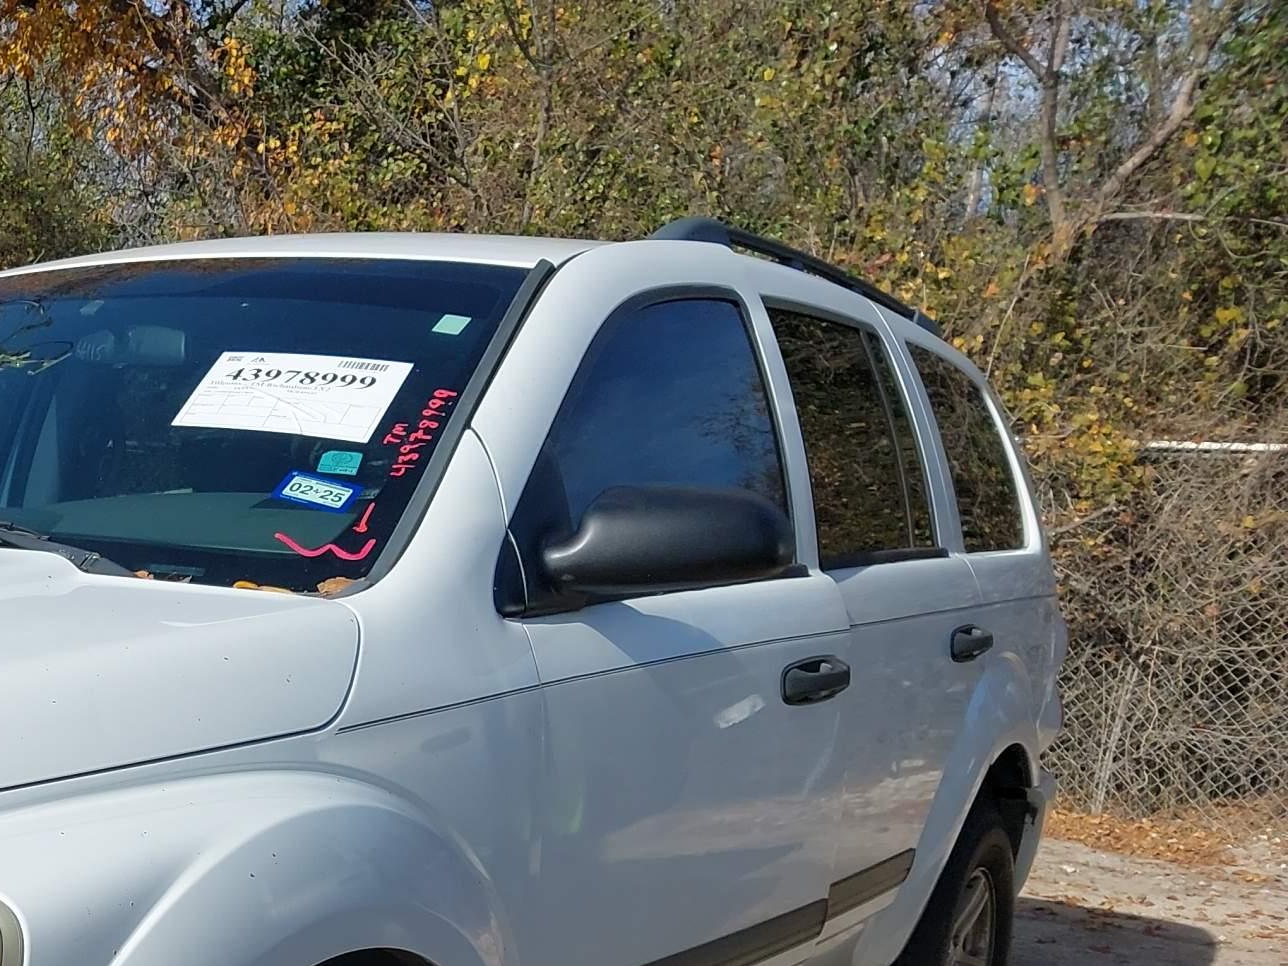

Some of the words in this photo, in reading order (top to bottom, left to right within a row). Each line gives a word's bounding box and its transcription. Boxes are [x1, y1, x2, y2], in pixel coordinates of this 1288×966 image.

[226, 367, 377, 389] 43978999
[390, 389, 458, 476] 43978999
[289, 482, 314, 496] 02
[318, 489, 345, 503] 25
